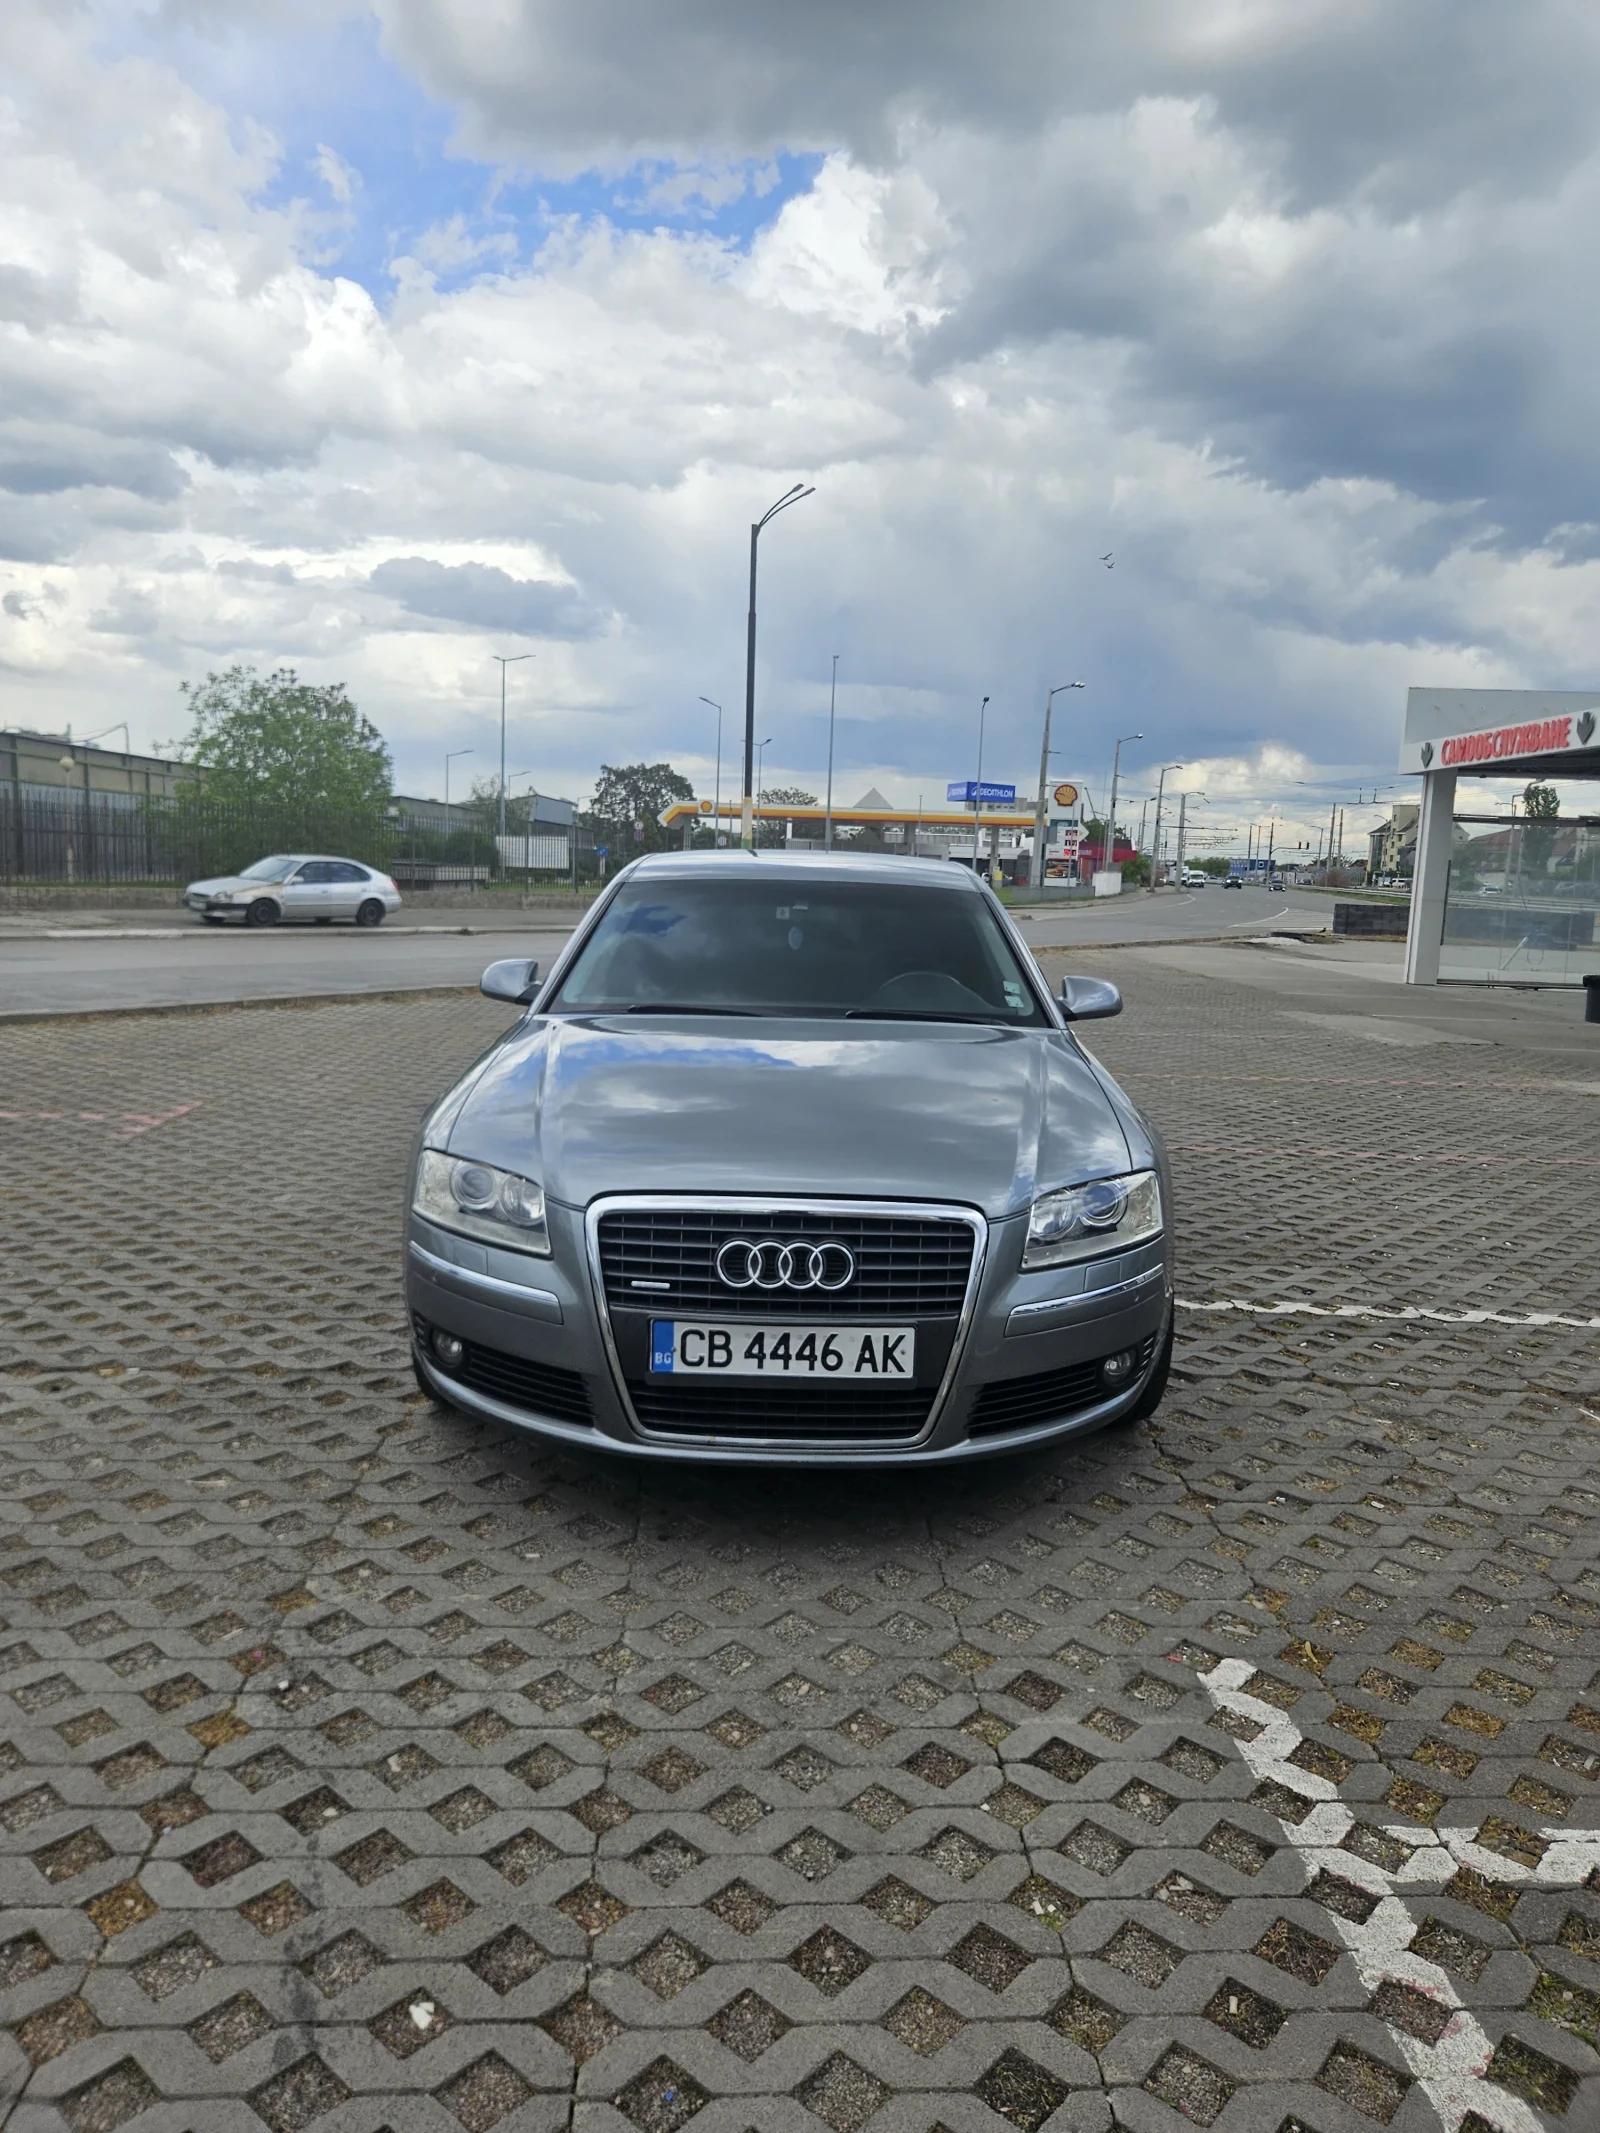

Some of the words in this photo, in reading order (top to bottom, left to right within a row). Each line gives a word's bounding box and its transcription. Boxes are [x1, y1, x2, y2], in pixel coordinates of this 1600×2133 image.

[1441, 717, 1573, 766] САМООБСЛУЖВАНЕ
[980, 788, 1013, 798] DECATHLON
[654, 1352, 672, 1364] BG
[680, 1329, 733, 1368] CB
[744, 1331, 843, 1371] 4446
[854, 1334, 907, 1373] AK
